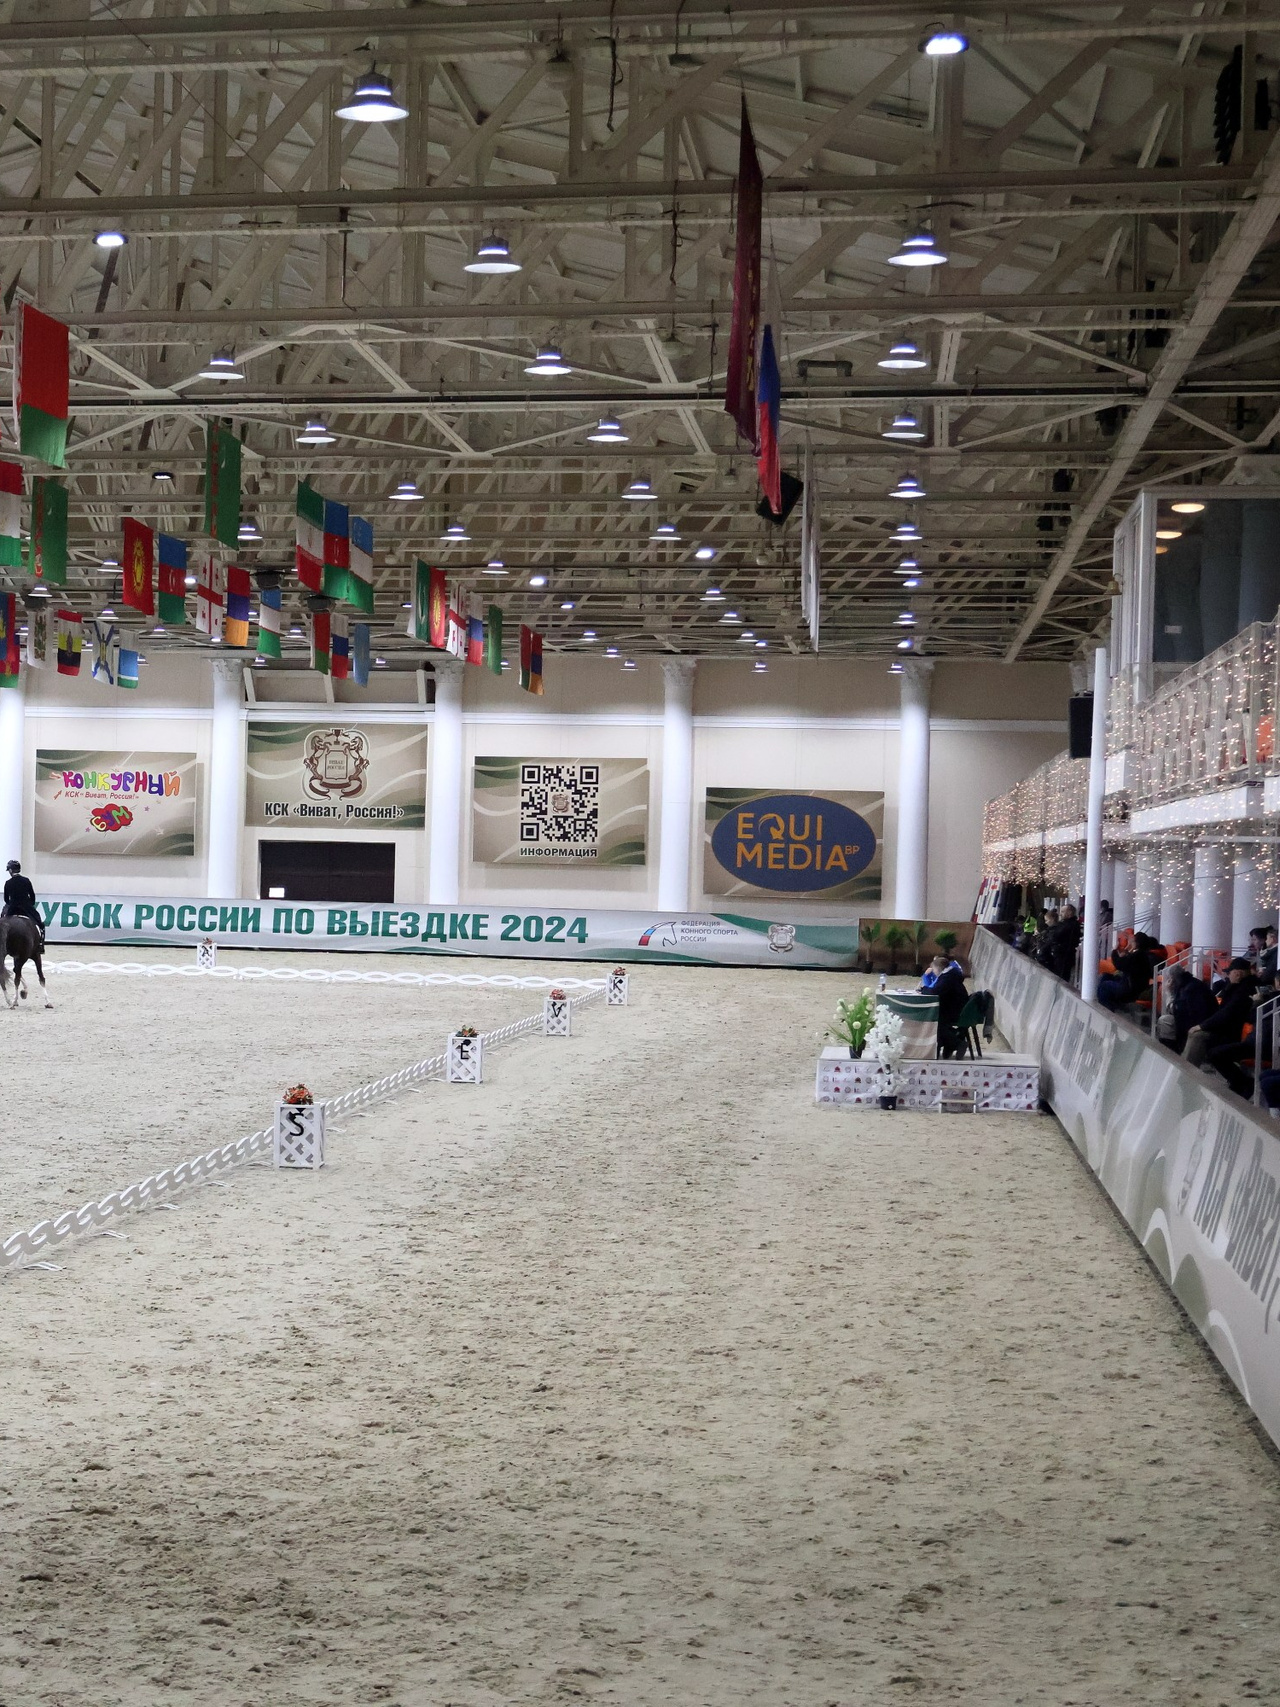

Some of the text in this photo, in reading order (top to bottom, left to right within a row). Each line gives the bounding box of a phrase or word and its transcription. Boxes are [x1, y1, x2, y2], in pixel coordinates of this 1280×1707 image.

[62, 770, 180, 797] КОНКУРНЫЙ
[265, 802, 404, 820] КСК «Виват, Россия!»
[737, 812, 823, 841] EQUI
[520, 847, 597, 858] ИНФОРМАЦИЯ
[736, 842, 848, 872] MEDIA
[34, 901, 589, 943] УБОК РОССИИ ПО ВЫЕЗДКЕ 2024
[460, 1043, 470, 1060] E
[289, 1112, 304, 1136] S
